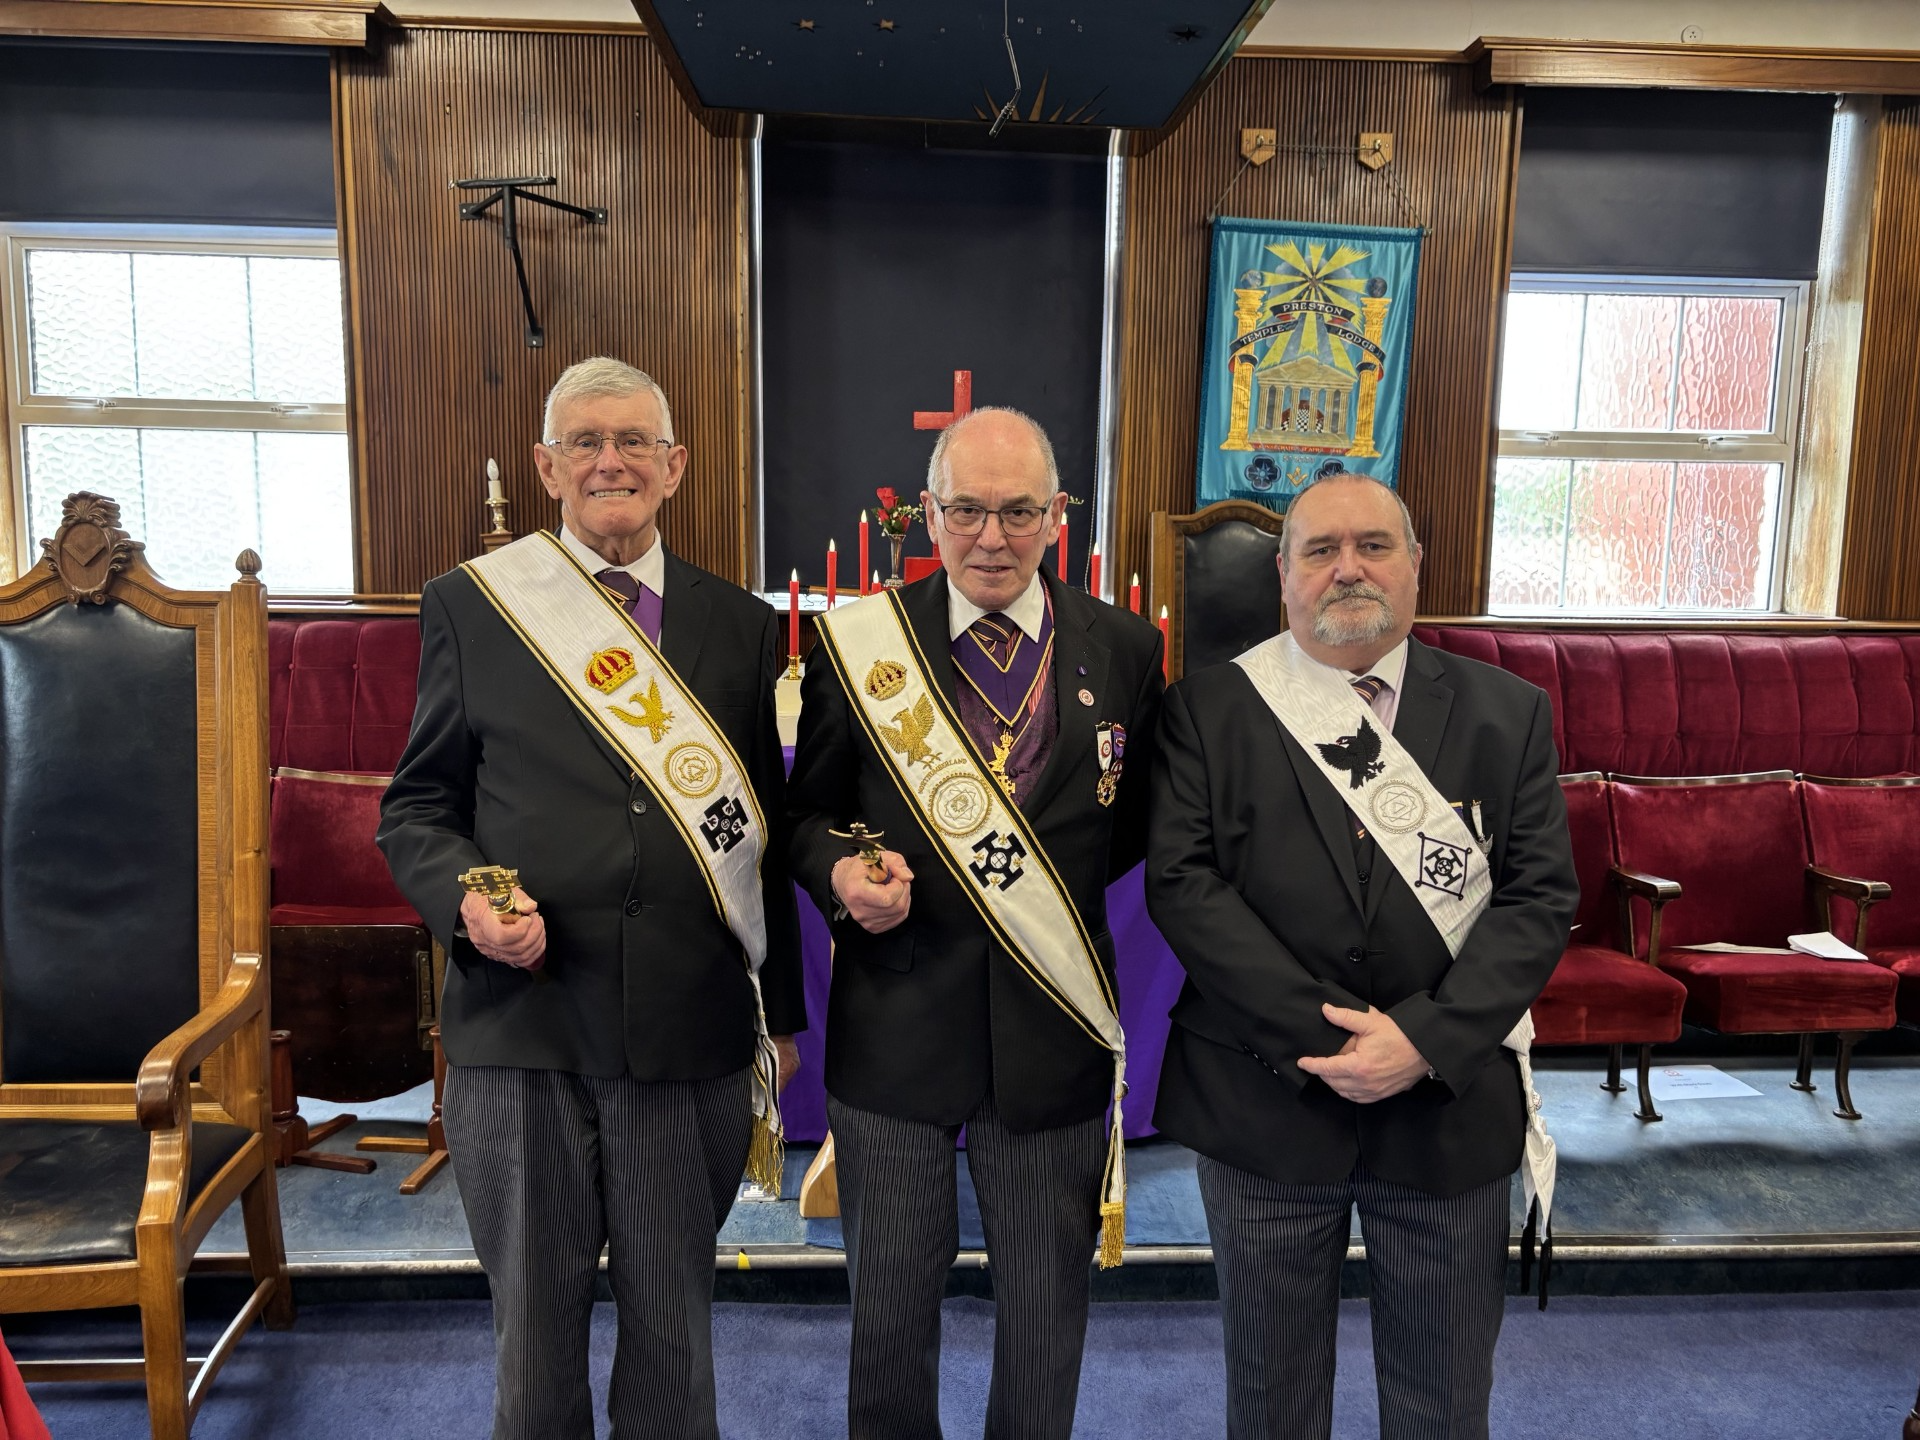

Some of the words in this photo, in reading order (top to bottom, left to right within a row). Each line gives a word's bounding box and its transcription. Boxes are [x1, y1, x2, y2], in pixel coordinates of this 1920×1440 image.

[1283, 302, 1343, 316] PRESTON
[1240, 324, 1285, 345] TEMPLE
[1338, 328, 1376, 351] LODGE
[918, 758, 967, 794] NORTHUMBERLAND
